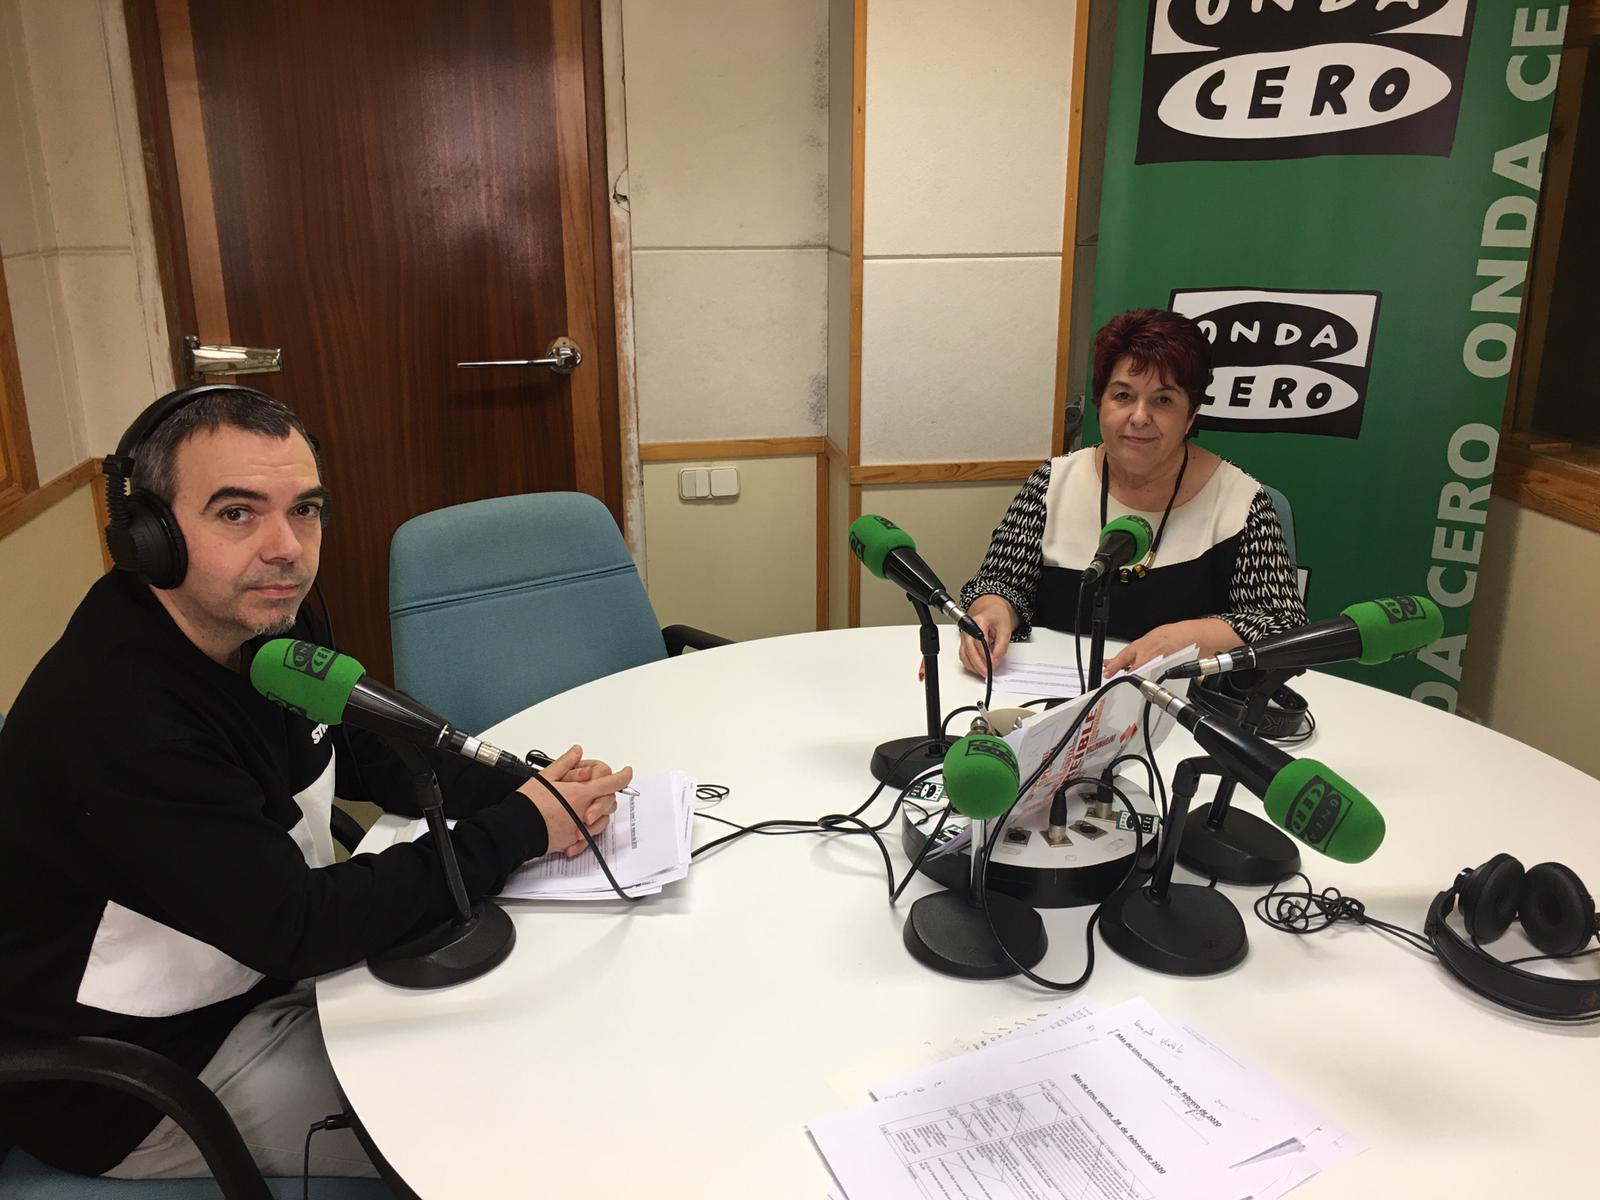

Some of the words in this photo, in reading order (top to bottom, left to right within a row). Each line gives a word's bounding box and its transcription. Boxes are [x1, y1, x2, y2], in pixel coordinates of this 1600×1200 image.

[1196, 64, 1410, 120] CERO
[1463, 133, 1549, 378] ONDA
[1427, 423, 1500, 607] CERO
[1079, 1082, 1089, 1091] de
[1112, 1117, 1121, 1127] 28
[1119, 1125, 1129, 1135] de
[1126, 1133, 1147, 1155] febrero
[1143, 1152, 1153, 1162] de
[1150, 1159, 1166, 1175] 2020
[1172, 1083, 1182, 1092] de
[1206, 1113, 1222, 1128] 2020
